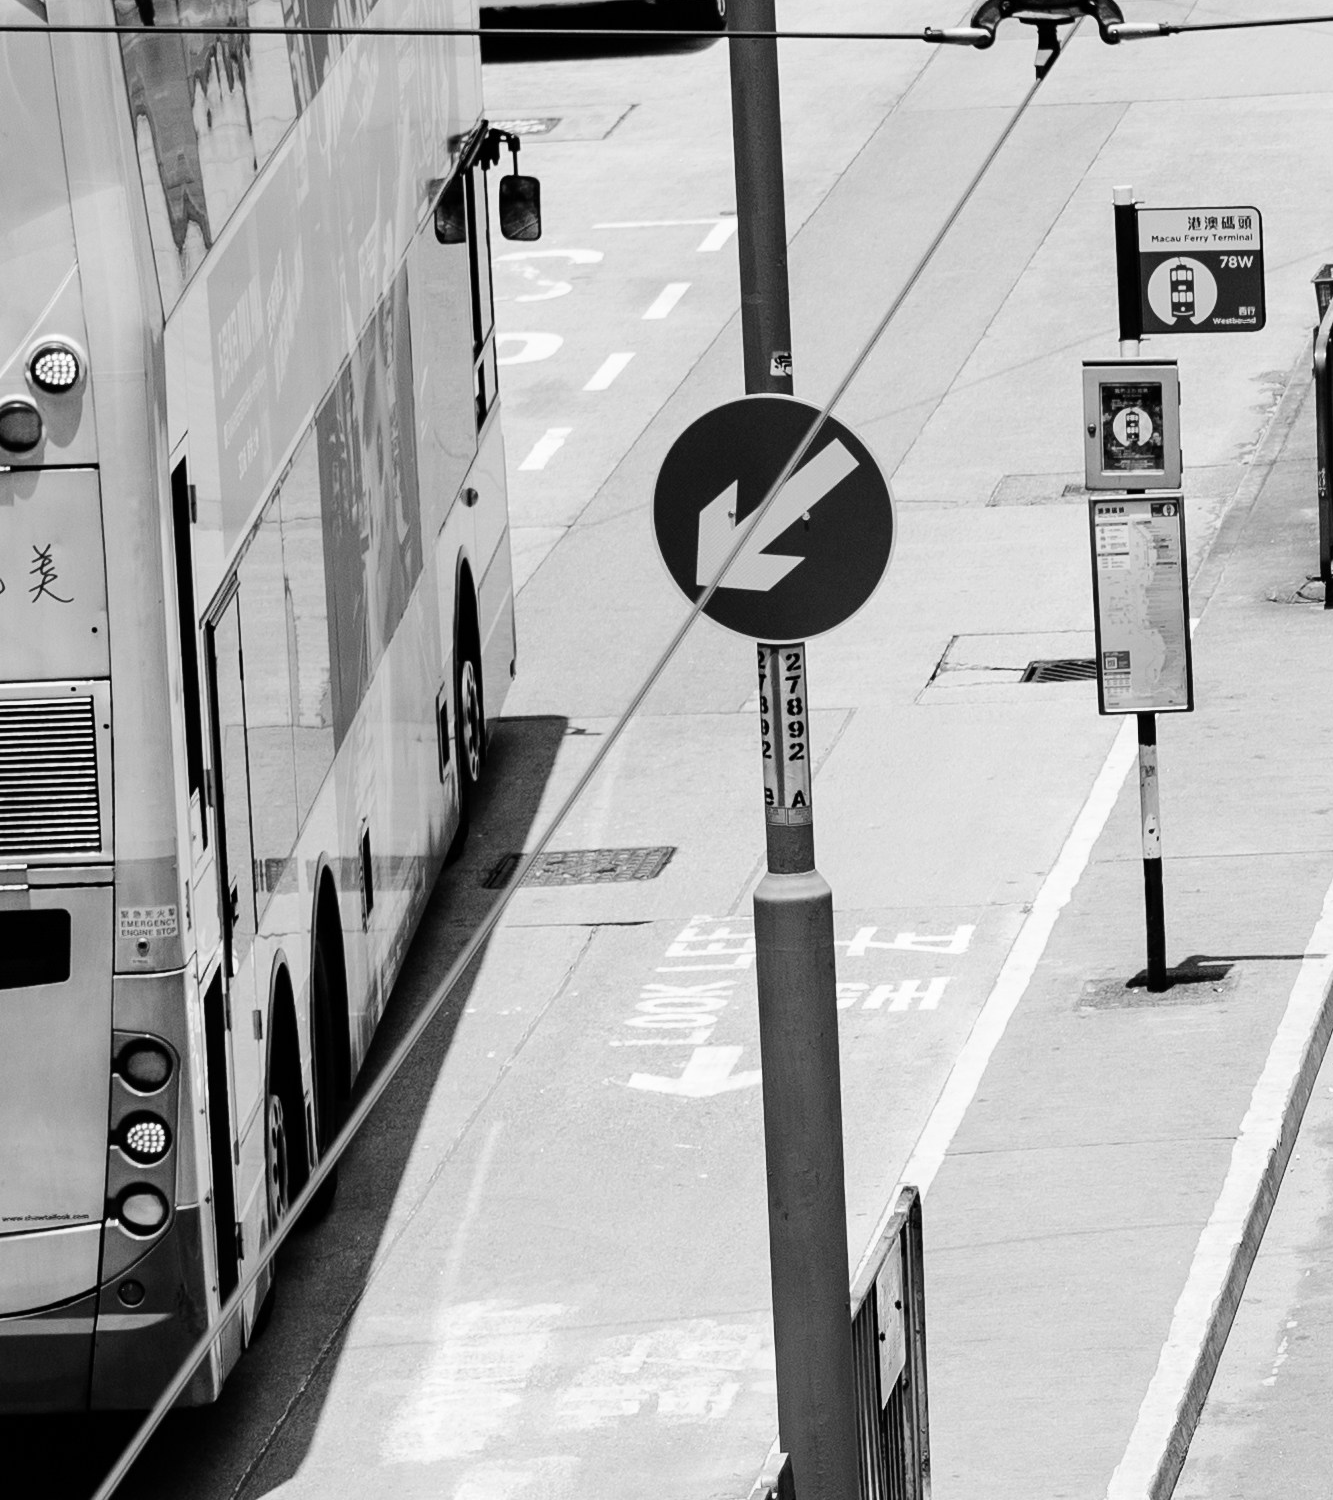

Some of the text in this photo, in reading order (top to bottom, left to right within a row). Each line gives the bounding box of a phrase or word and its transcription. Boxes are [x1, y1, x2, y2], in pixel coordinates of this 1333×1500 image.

[1187, 216, 1253, 231] 港澳碼頭
[1151, 233, 1253, 244] Macau Ferry Terminal
[1220, 255, 1254, 269] 78W
[1212, 317, 1257, 325] Westbound
[785, 652, 807, 808] 27892 A
[120, 918, 176, 929] EMERGENCY
[121, 927, 177, 937] ENGINE STOP
